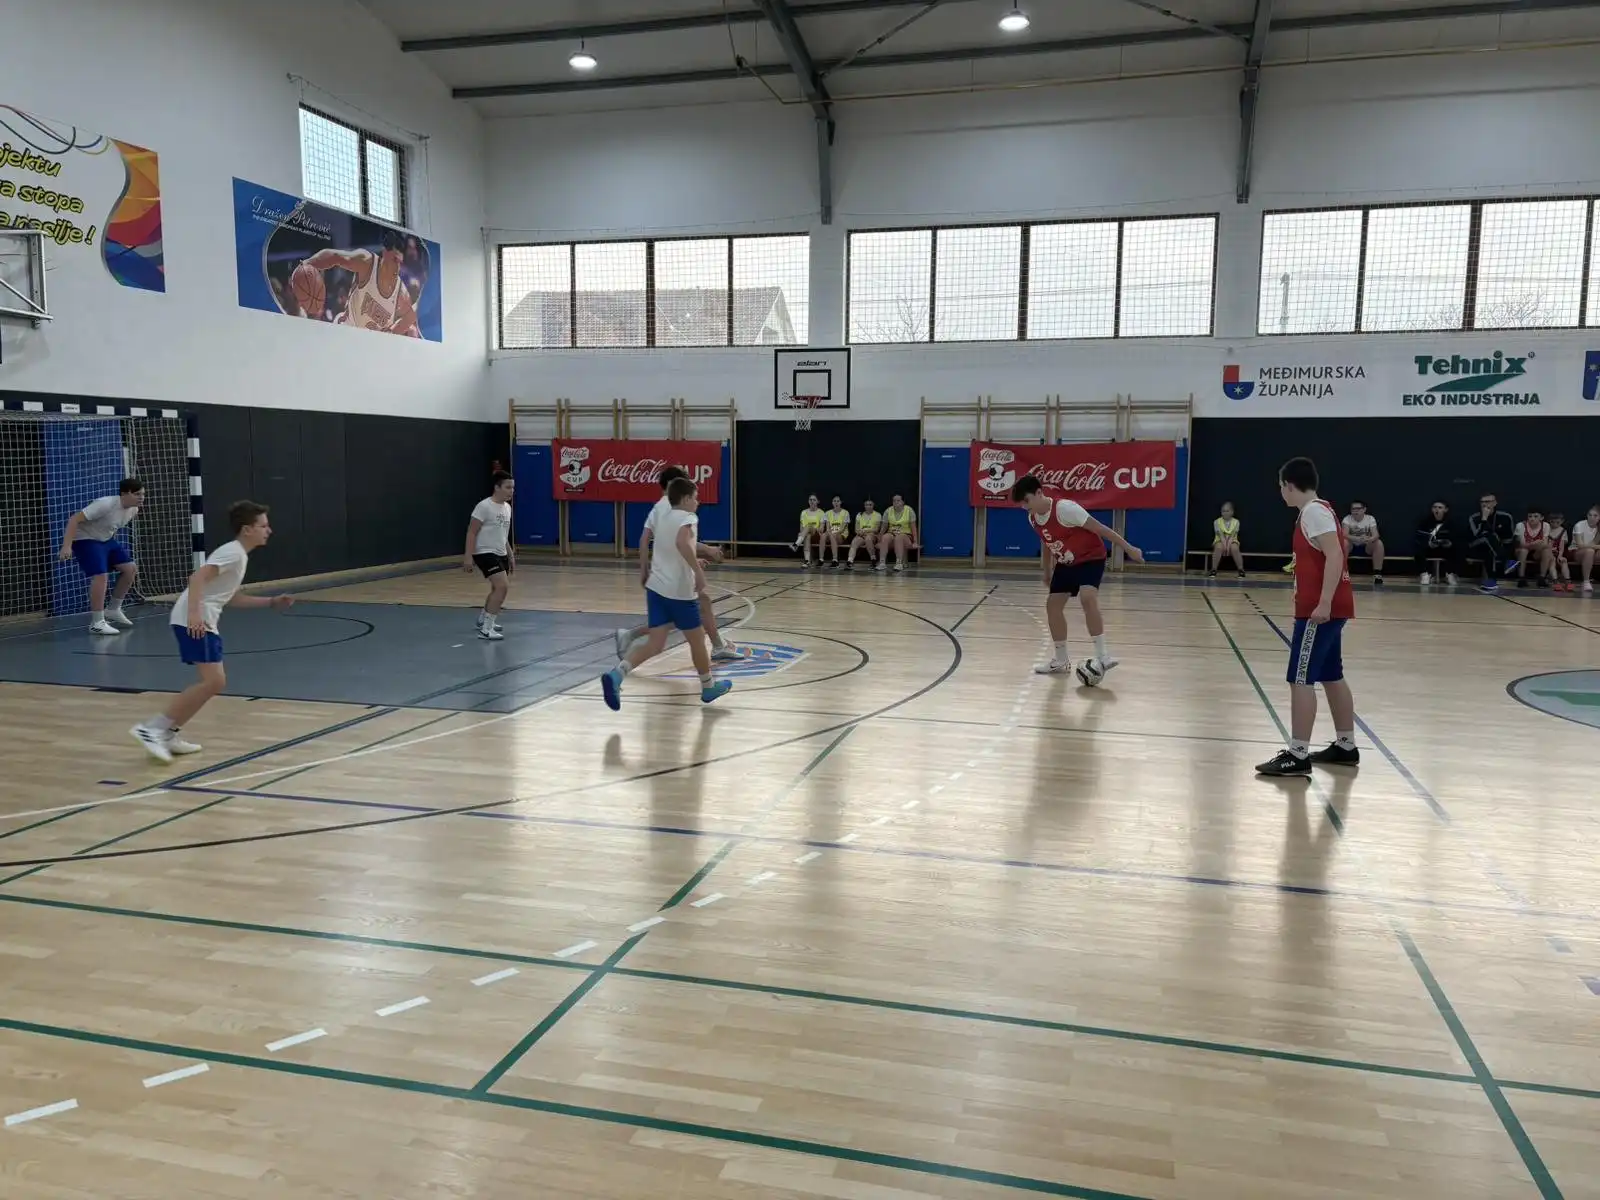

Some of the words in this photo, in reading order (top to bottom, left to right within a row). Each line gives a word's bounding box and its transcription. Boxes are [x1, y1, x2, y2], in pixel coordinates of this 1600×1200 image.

[0, 179, 16, 198] a
[18, 185, 84, 213] stopa
[1259, 366, 1366, 380] MEĐIMURSKA
[1414, 350, 1528, 375] Tehnix
[1258, 381, 1334, 399] ŽUPANIJA
[1402, 394, 1436, 406] EKO
[1441, 393, 1541, 406] INDUSTRIJA
[674, 464, 713, 485] UP
[1113, 466, 1168, 490] CUP
